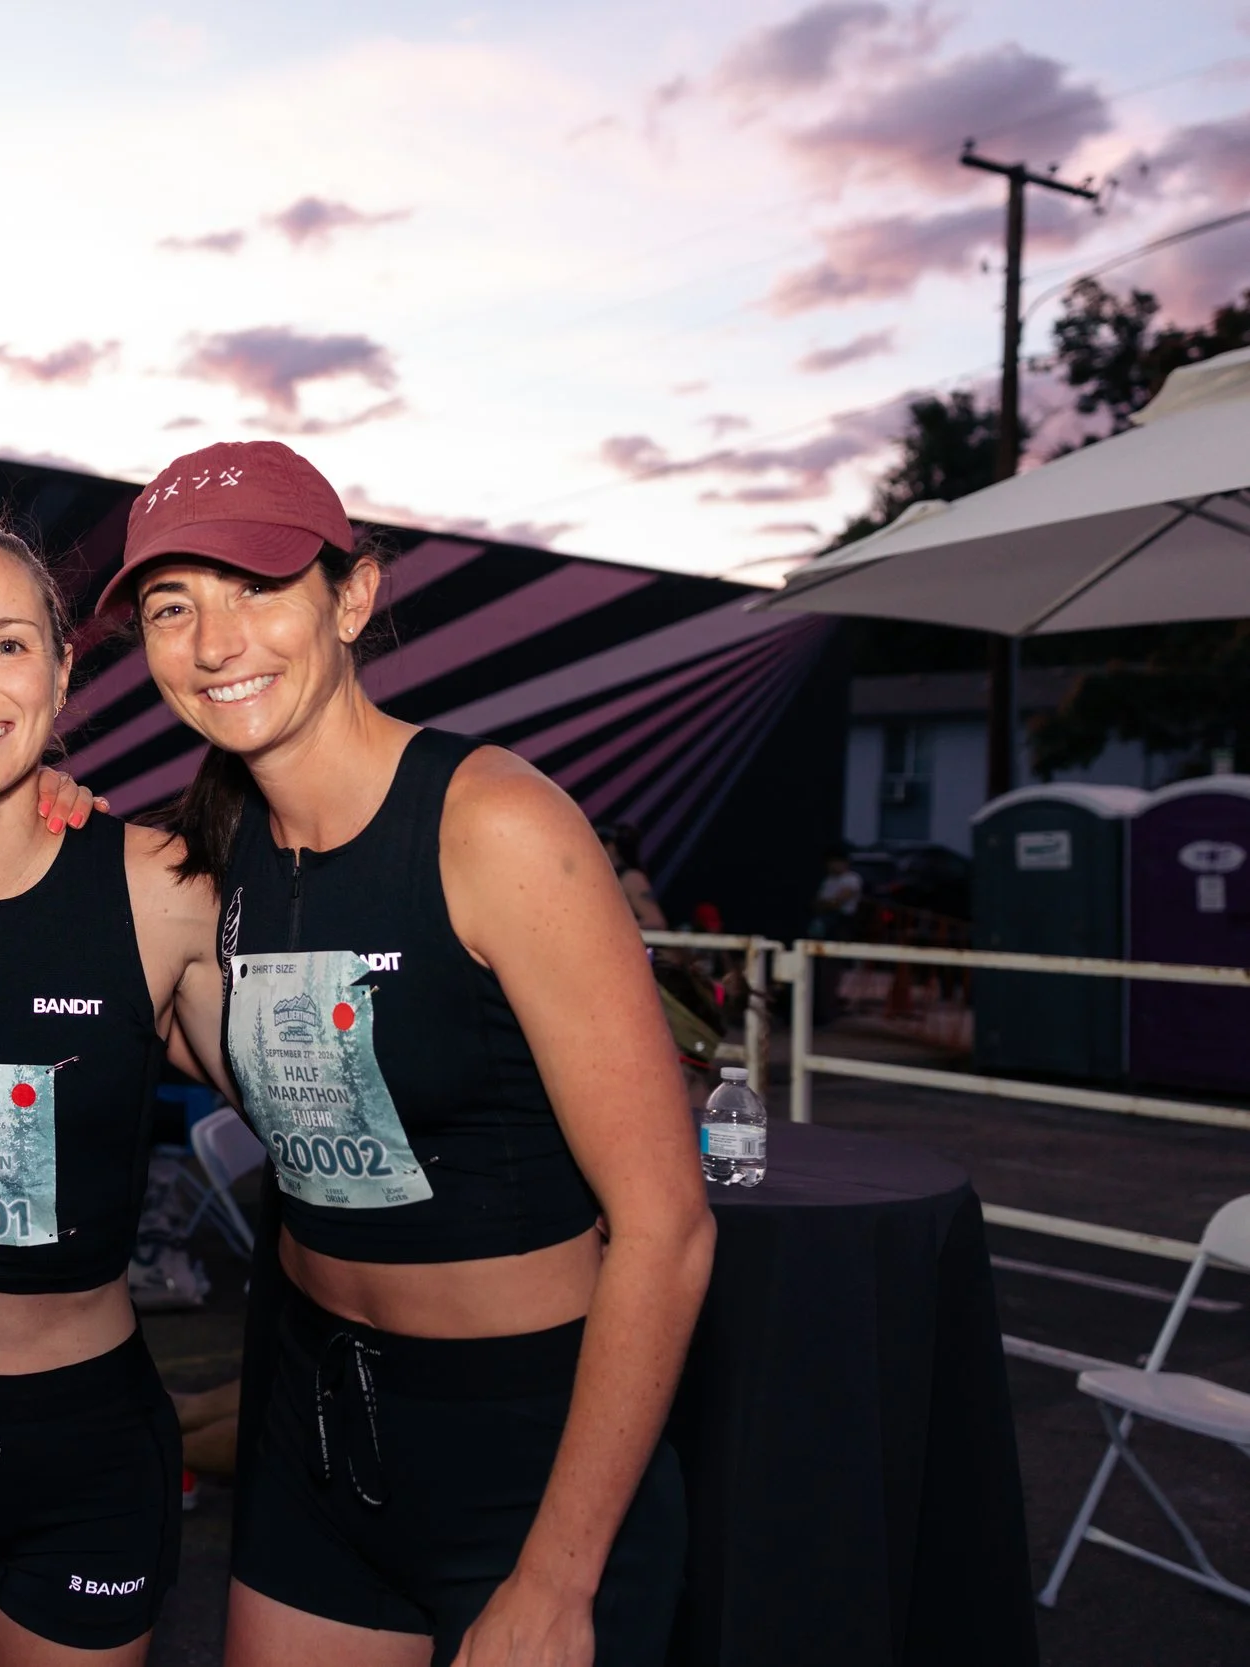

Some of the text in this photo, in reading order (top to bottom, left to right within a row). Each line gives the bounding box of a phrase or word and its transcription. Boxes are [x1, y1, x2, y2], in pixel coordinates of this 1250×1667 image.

[252, 965, 274, 975] SHIRT
[33, 998, 103, 1015] BANDIT
[265, 1048, 302, 1058] SEPTEMBER
[318, 1051, 334, 1059] 2026
[284, 1066, 320, 1083] HALF
[267, 1085, 350, 1104] MARATHON
[292, 1109, 334, 1128] FLUEHR
[271, 1130, 396, 1179] 20002
[324, 1195, 350, 1204] DRINK
[385, 1194, 409, 1203] Eats
[85, 1576, 145, 1596] BANDIT
